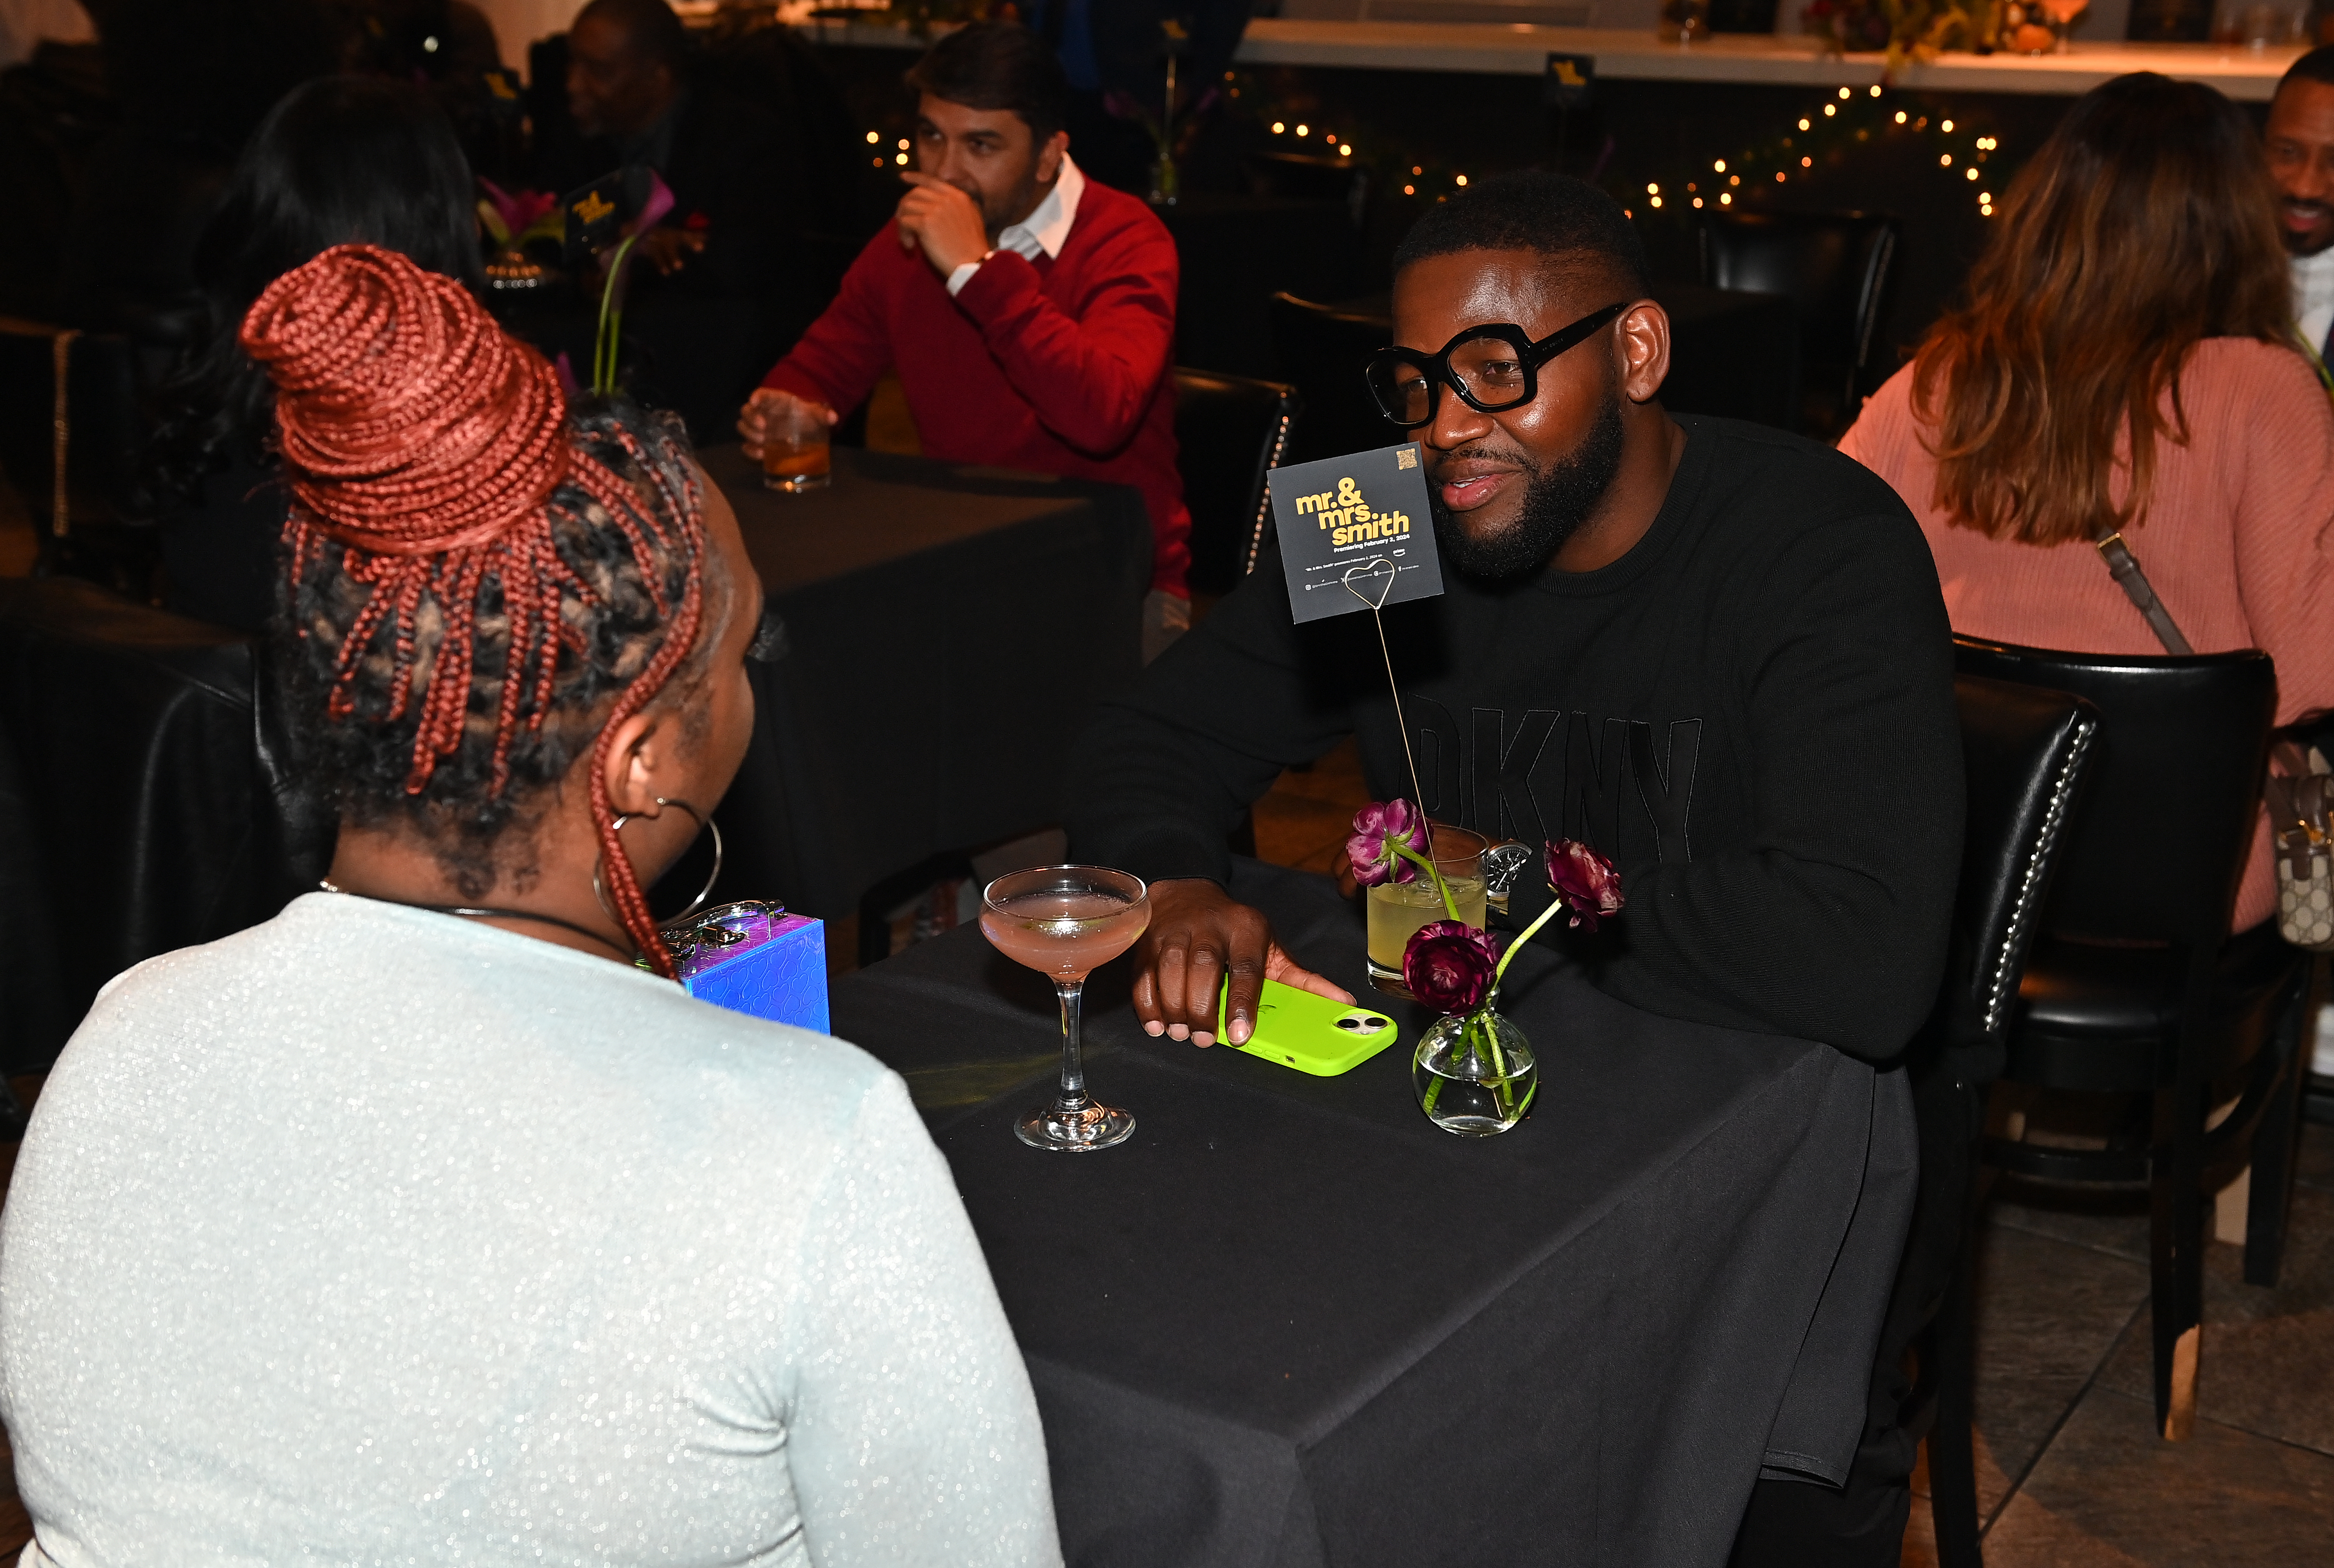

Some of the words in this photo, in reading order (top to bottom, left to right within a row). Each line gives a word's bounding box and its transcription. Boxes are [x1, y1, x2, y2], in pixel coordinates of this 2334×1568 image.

[1318, 504, 1378, 529] mrs.
[1332, 510, 1409, 545] smith
[1334, 543, 1364, 553] Premiering
[1364, 538, 1388, 547] February
[1399, 692, 1703, 863] DKNY
